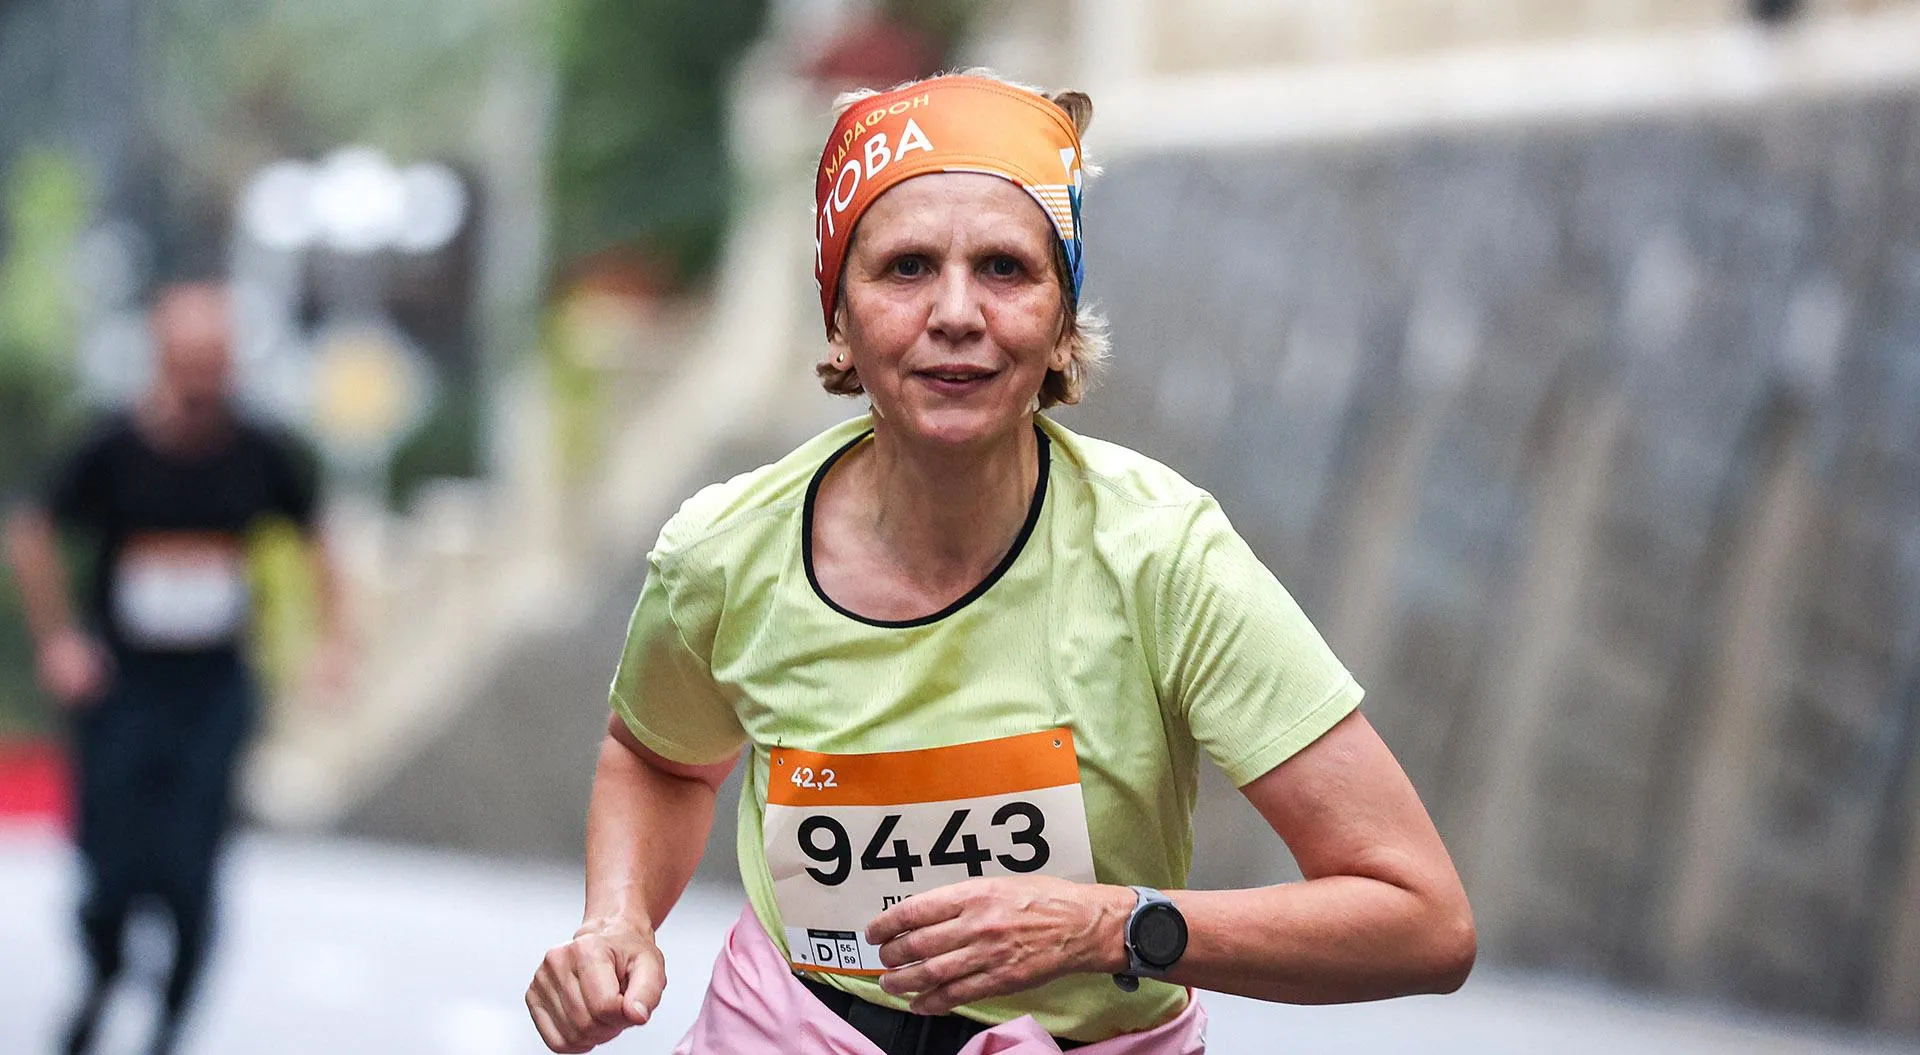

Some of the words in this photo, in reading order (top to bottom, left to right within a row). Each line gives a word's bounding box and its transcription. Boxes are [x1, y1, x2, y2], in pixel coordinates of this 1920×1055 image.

[825, 94, 929, 183] МАРАФОН
[815, 117, 934, 290] УТОВА
[791, 766, 838, 791] 42,2
[797, 801, 1051, 886] 9443
[816, 943, 833, 962] D
[844, 955, 856, 964] 59
